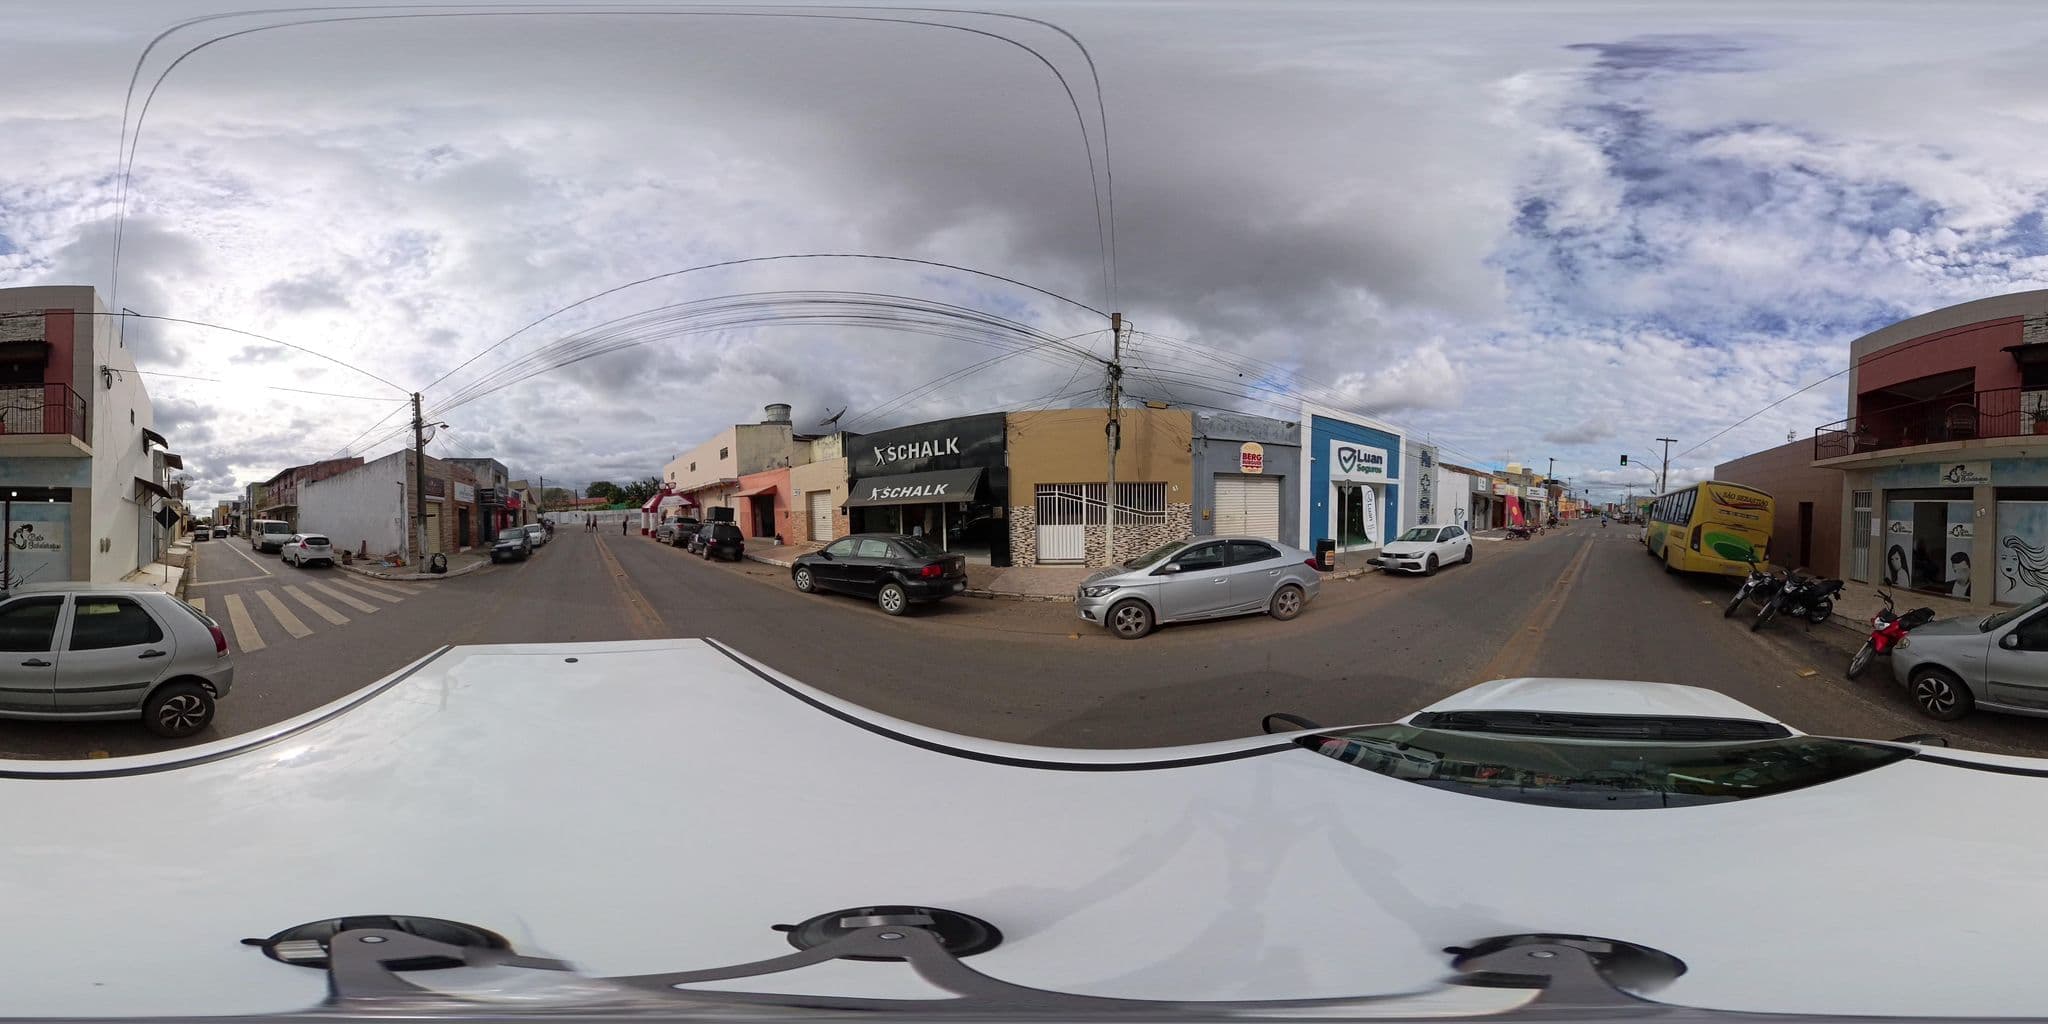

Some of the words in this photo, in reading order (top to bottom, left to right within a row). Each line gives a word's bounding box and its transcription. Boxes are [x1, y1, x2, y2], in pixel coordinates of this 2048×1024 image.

[887, 437, 960, 462] SCHALK
[1242, 452, 1262, 461] BERG
[1358, 449, 1383, 465] Luan
[1357, 463, 1383, 475] Seguros
[880, 483, 949, 499] SCHALK
